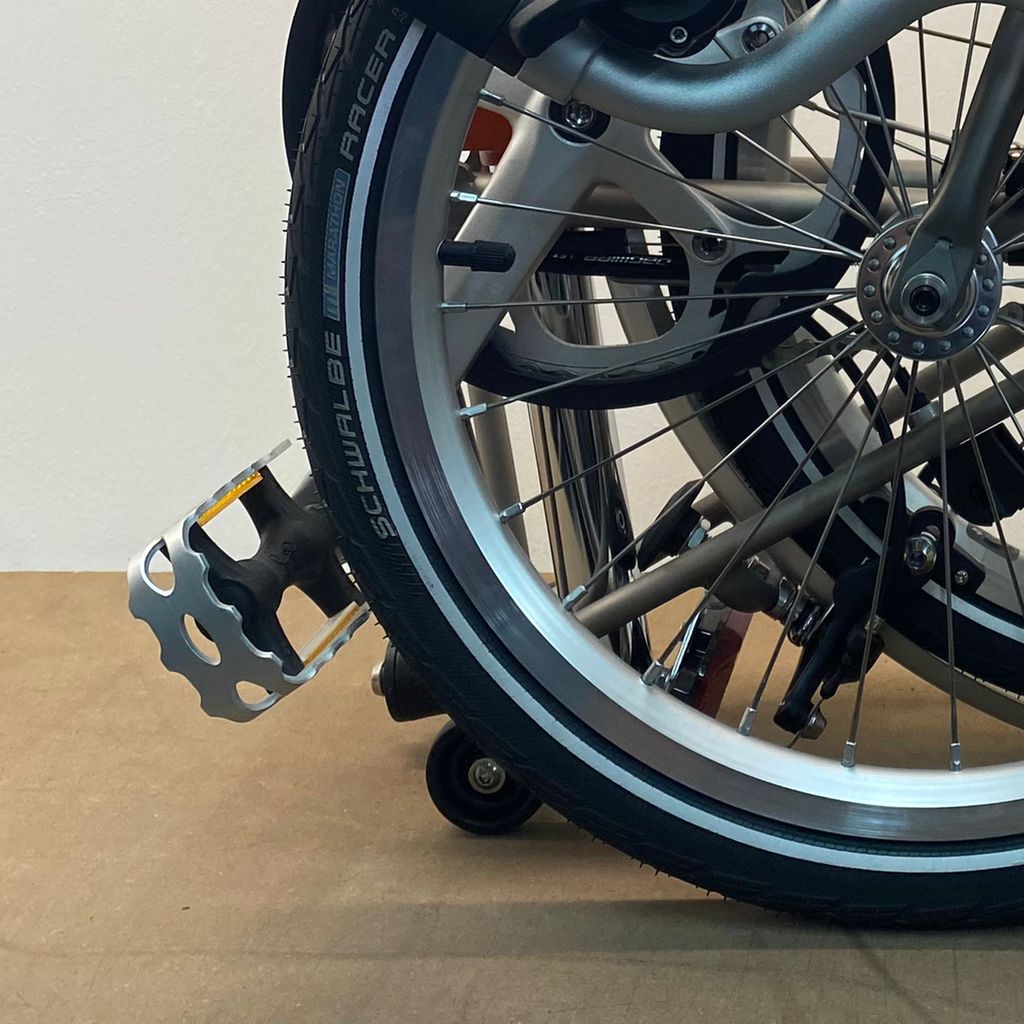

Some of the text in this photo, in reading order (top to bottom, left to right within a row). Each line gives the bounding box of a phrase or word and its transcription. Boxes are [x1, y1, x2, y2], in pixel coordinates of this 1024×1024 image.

[324, 28, 398, 539] SCHWALBE MARATHON RACER
